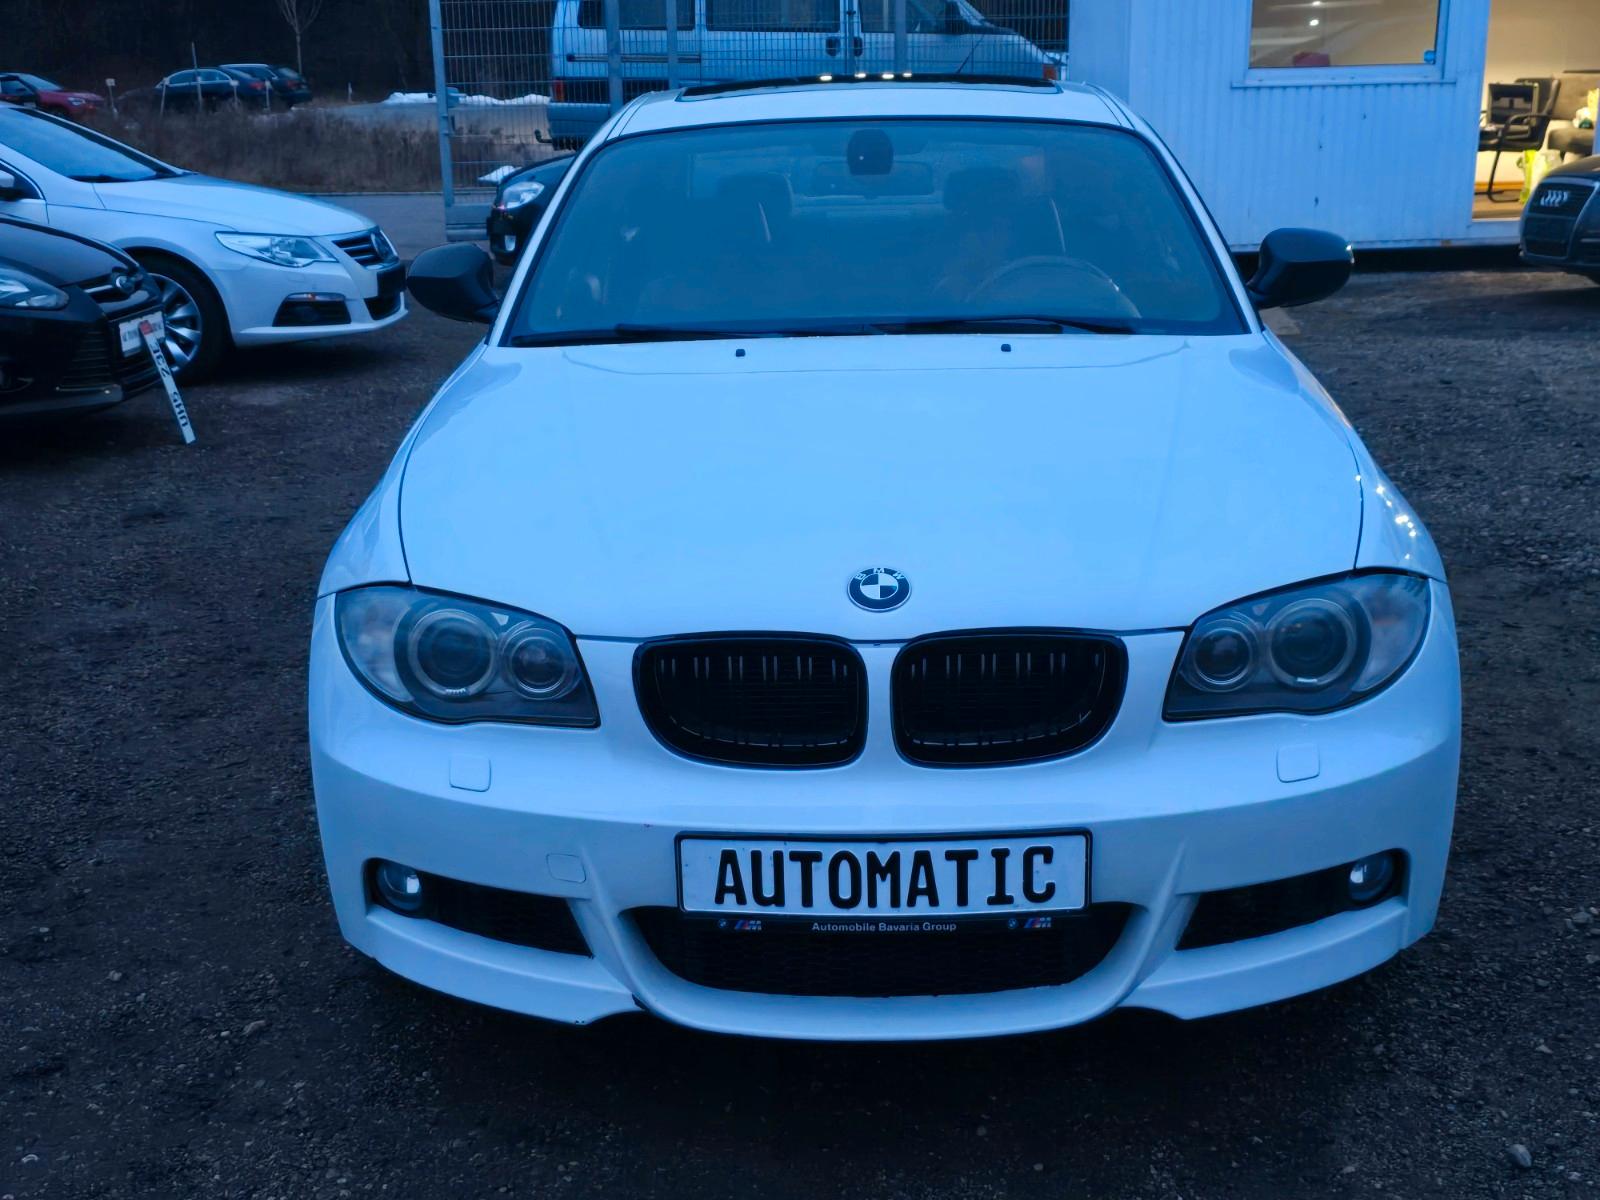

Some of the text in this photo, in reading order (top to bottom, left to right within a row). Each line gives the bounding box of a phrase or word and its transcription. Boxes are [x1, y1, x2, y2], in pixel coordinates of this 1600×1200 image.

[853, 567, 906, 580] BMW
[714, 845, 1057, 909] AUTOMATIC
[811, 921, 957, 932] Automobile Bavaria Group
